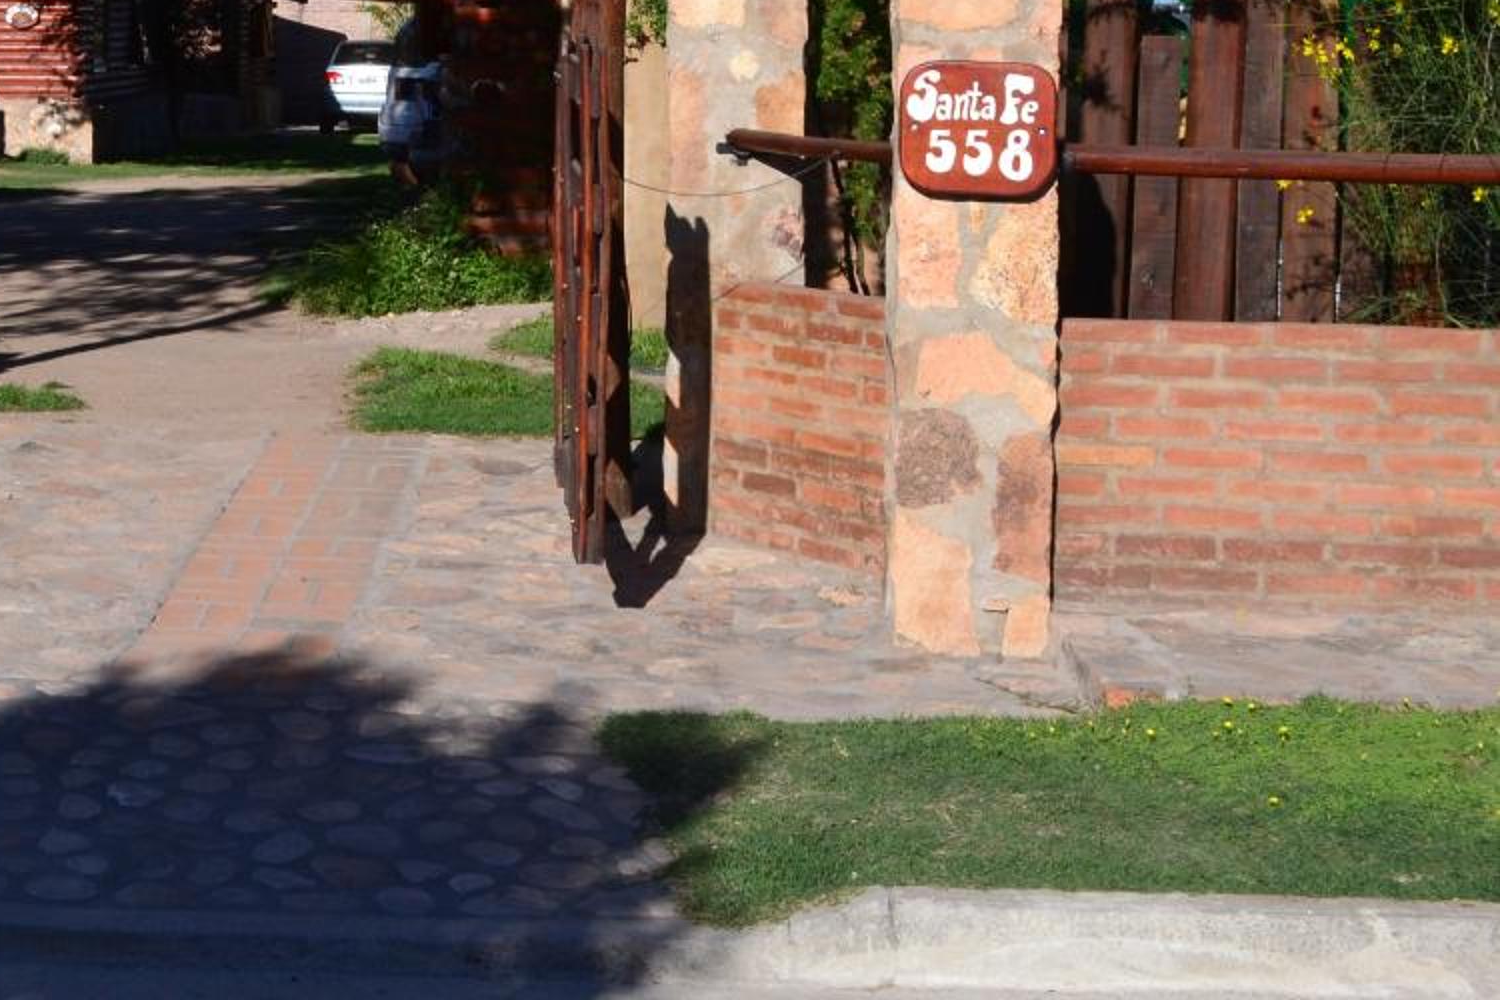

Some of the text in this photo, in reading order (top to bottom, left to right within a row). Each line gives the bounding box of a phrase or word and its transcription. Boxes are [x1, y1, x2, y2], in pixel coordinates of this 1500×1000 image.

[906, 70, 1039, 124] Santa Fe
[925, 129, 1033, 181] 558
